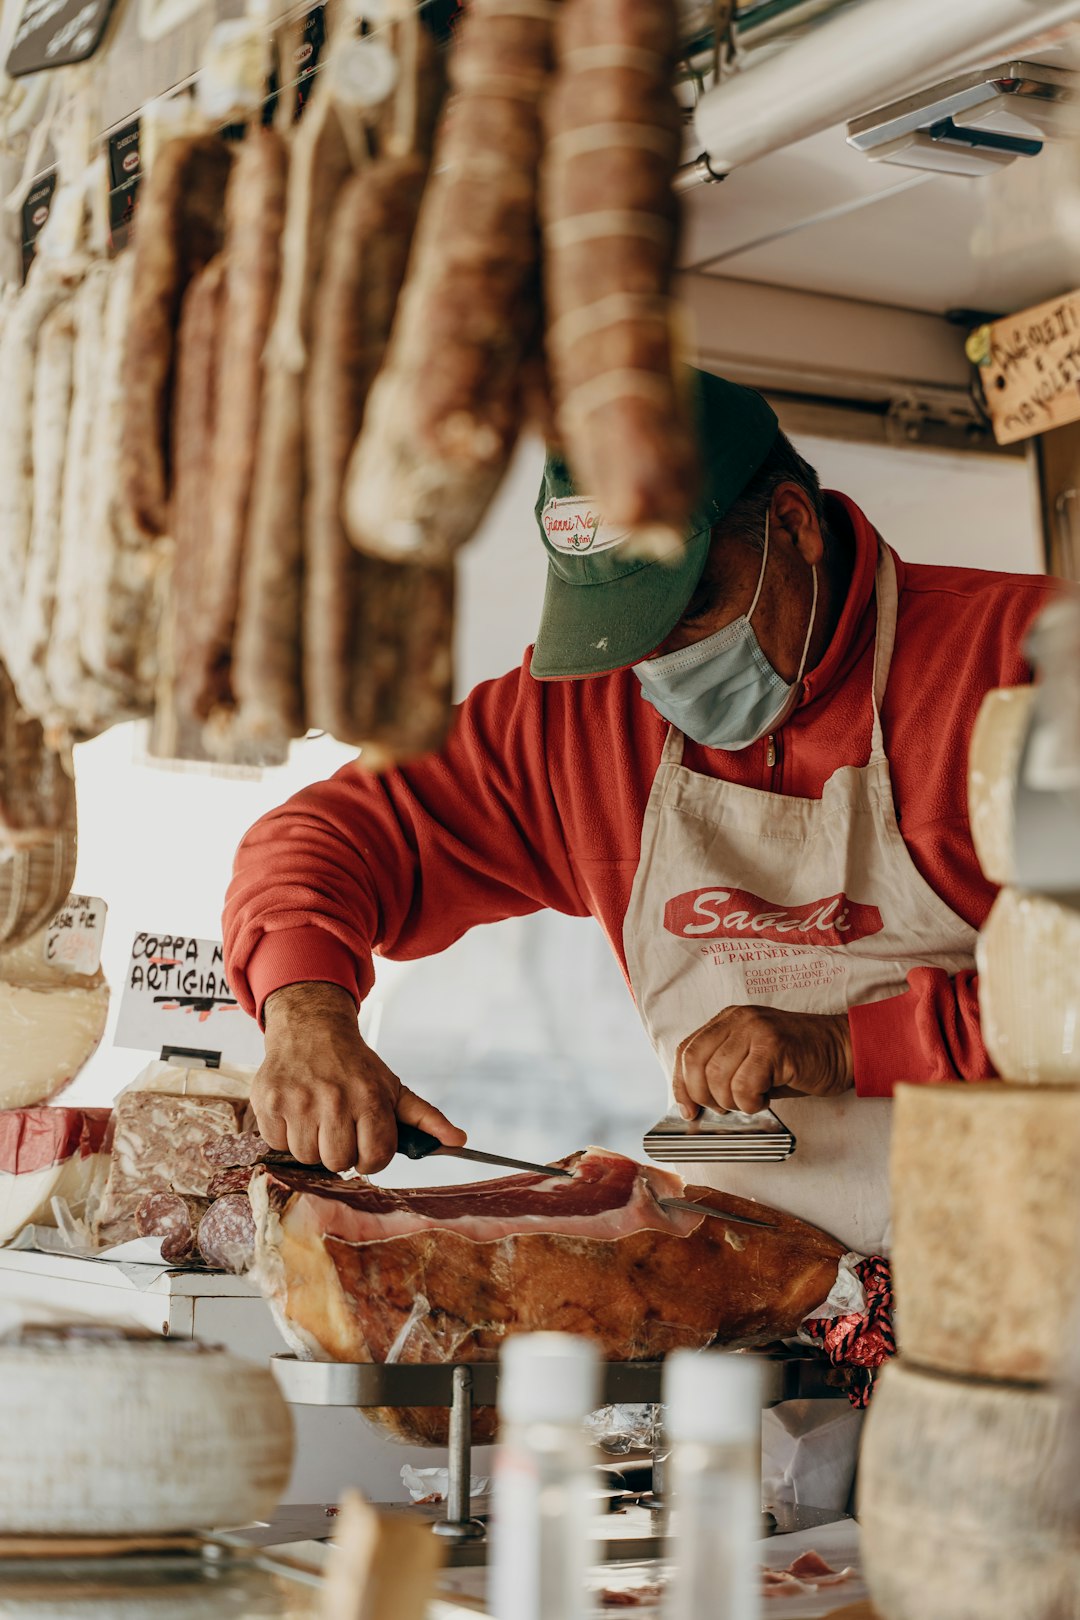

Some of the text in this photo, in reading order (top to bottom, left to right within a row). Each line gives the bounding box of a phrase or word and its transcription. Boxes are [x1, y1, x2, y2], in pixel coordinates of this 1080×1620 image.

[544, 515, 575, 537] Gianni
[682, 890, 851, 935] Sabelli
[131, 932, 223, 965] COPPA N
[700, 941, 751, 956] SABELLI
[728, 947, 790, 964] PARTNER
[744, 963, 808, 977] COLONNELLA
[745, 975, 778, 986] OSIMO
[778, 969, 825, 984] STAZIONE
[130, 962, 231, 999] ARTIGIAN
[746, 983, 779, 995] CHIETI
[780, 980, 812, 992] SCALO
